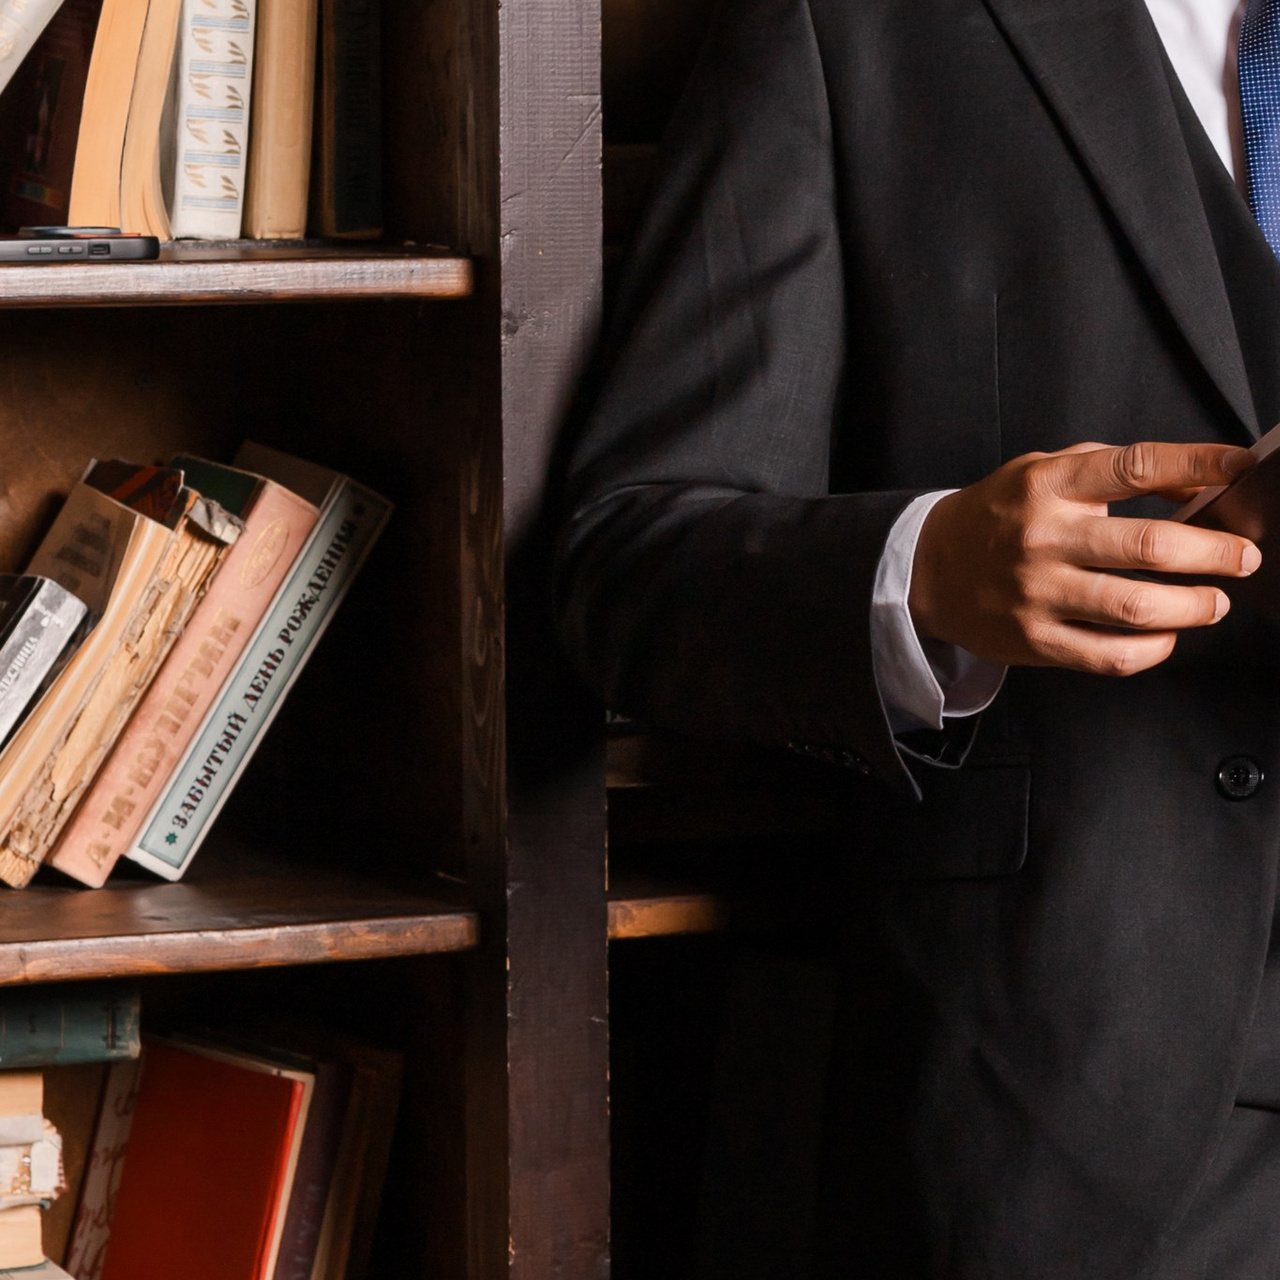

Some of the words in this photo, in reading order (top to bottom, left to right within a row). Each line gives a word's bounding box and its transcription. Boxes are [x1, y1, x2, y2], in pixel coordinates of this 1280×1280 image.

[171, 711, 248, 829] ЗАБЫТЫЙ
[244, 648, 286, 712] ДЕНЬ
[278, 520, 357, 648] РОЖДЕНИЯ
